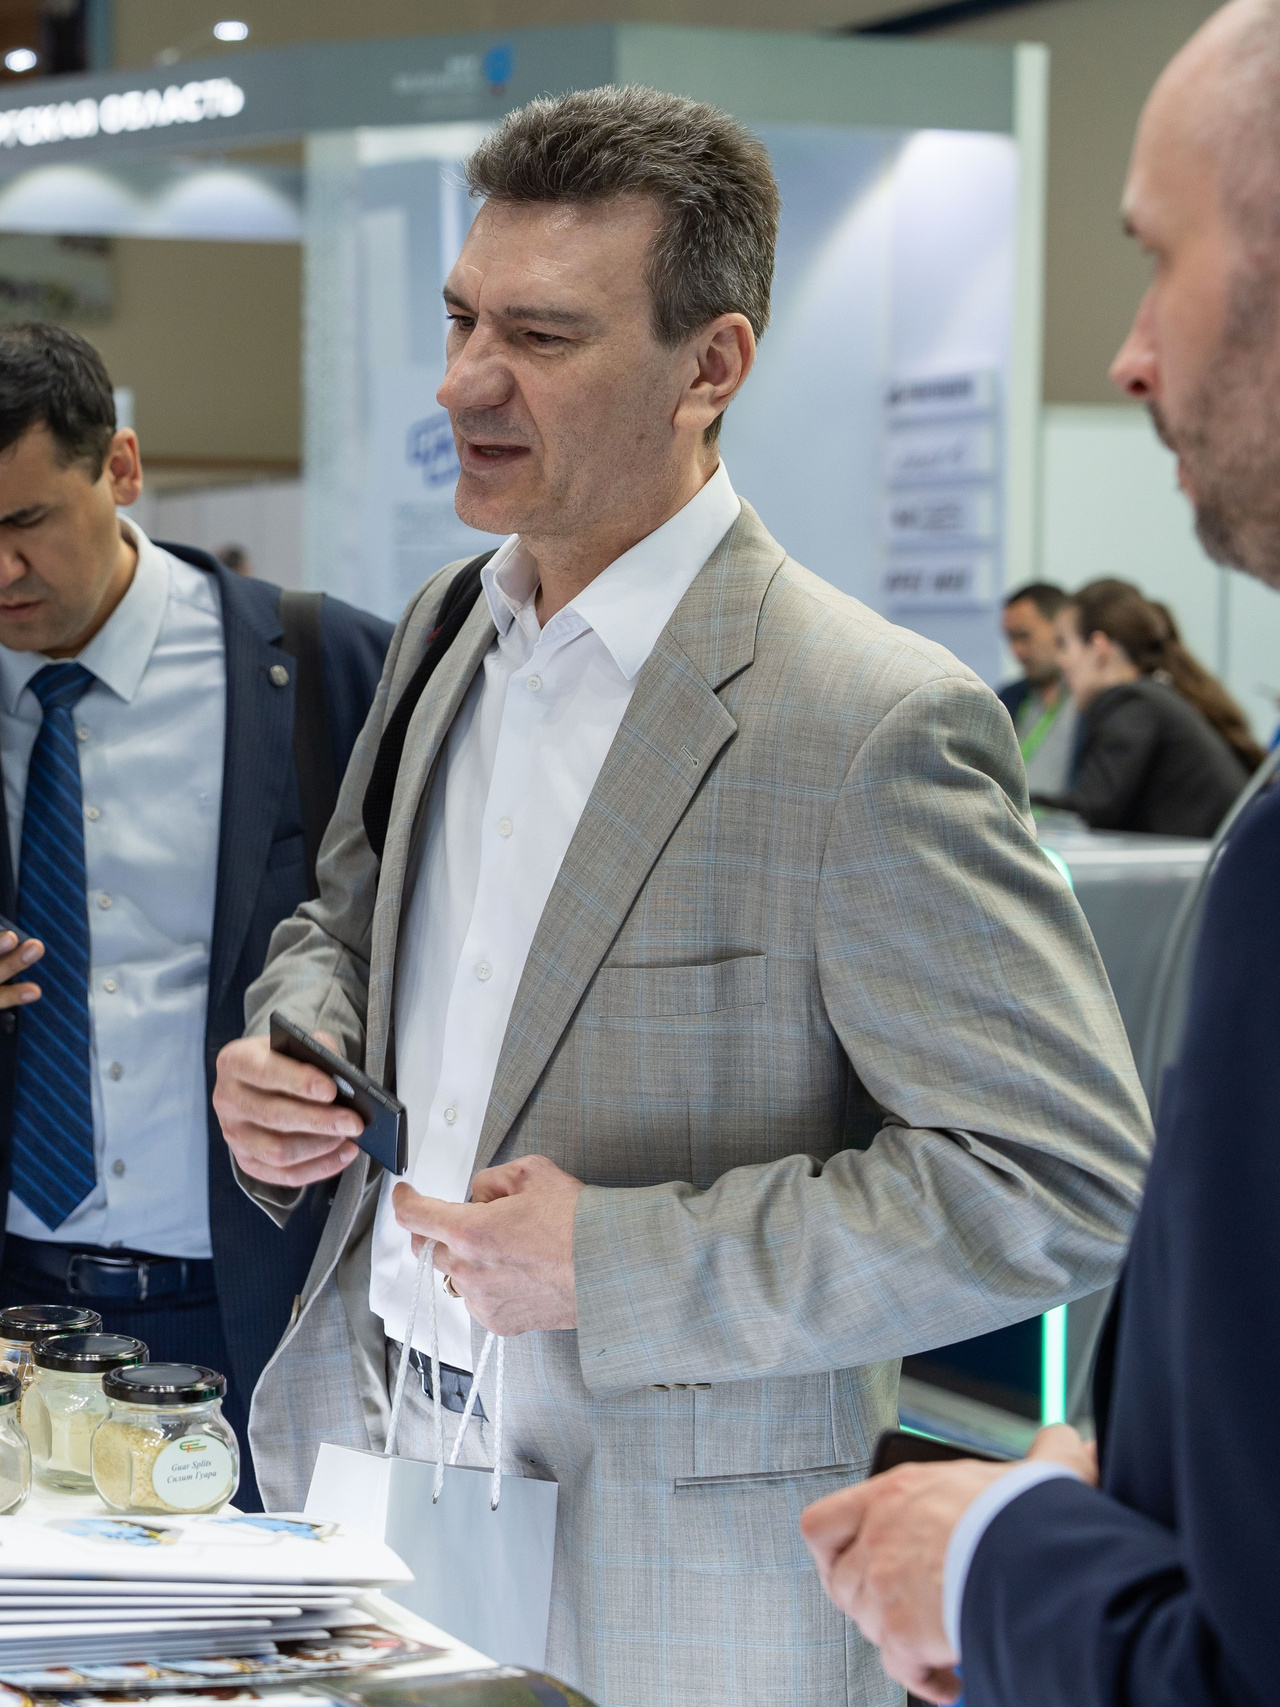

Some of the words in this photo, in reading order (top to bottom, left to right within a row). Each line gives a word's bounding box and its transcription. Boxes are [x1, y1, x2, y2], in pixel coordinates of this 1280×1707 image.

[172, 1463, 190, 1471] Guar
[192, 1460, 212, 1470] Splits
[167, 1475, 193, 1483] Сплит
[195, 1471, 217, 1480] Гуара
